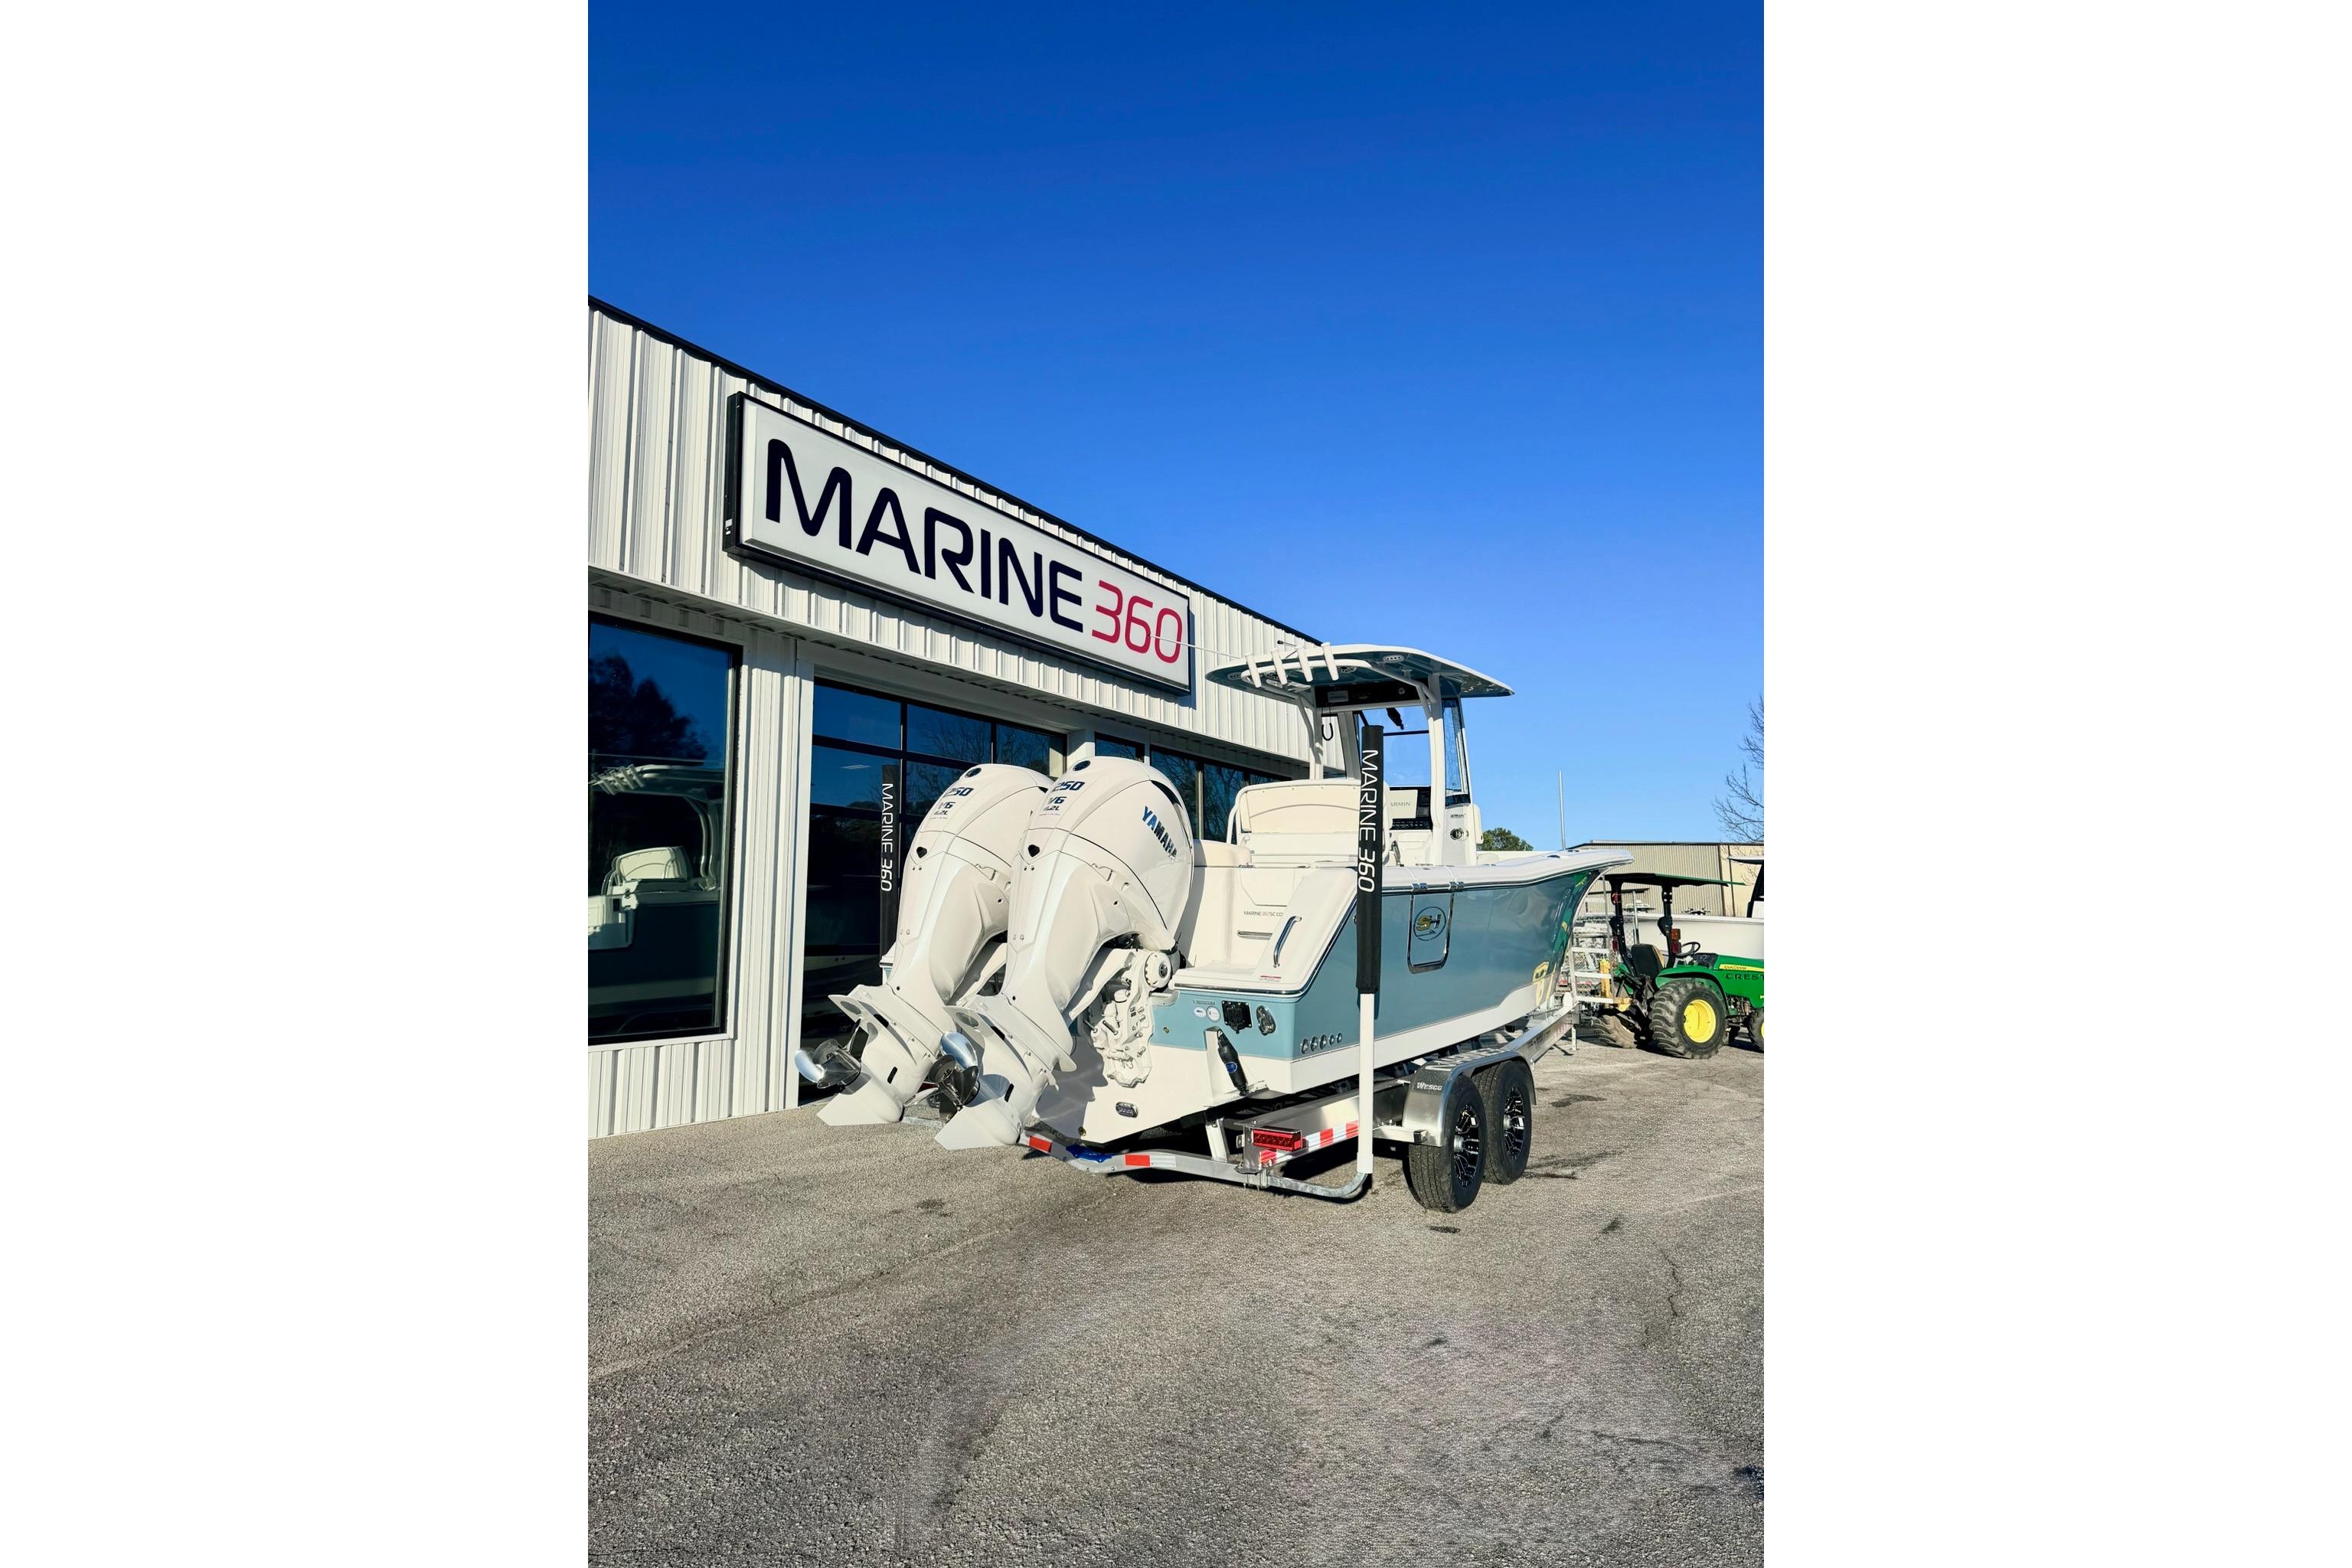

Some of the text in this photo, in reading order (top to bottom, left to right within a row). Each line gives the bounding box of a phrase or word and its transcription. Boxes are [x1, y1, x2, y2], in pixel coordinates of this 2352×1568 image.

[766, 439, 1182, 664] MARINE 360
[880, 783, 893, 892] MARINE 360
[1051, 780, 1086, 792] 250
[1142, 805, 1178, 864] YAMAHA
[1357, 750, 1379, 893] MARINE 360
